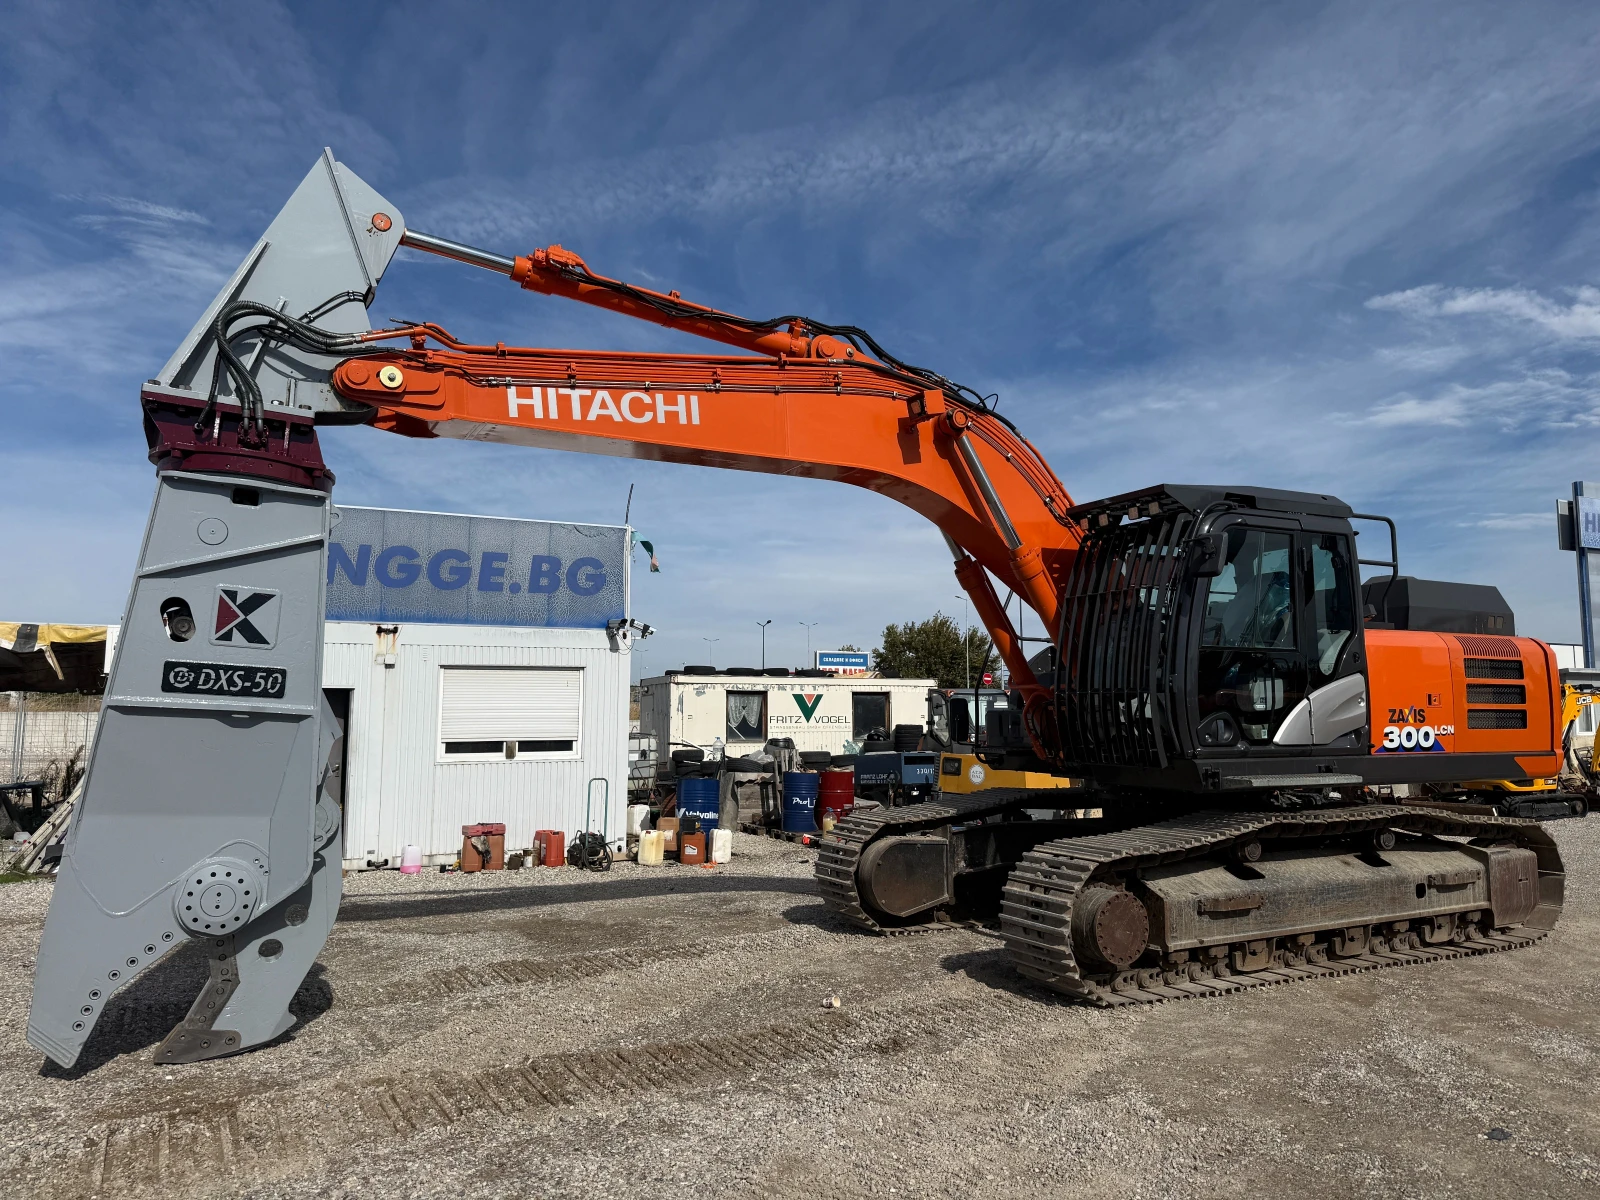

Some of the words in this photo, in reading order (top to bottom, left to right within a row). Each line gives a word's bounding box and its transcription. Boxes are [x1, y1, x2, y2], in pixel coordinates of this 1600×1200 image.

[507, 386, 700, 425] HITACHI
[1584, 512, 1600, 533] H
[1576, 695, 1593, 705] JCB
[769, 715, 802, 723] FRITZ
[813, 715, 851, 723] VOGEL
[1388, 705, 1426, 723] ZAXIS
[1383, 726, 1435, 750] 300
[1434, 725, 1455, 735] LCN
